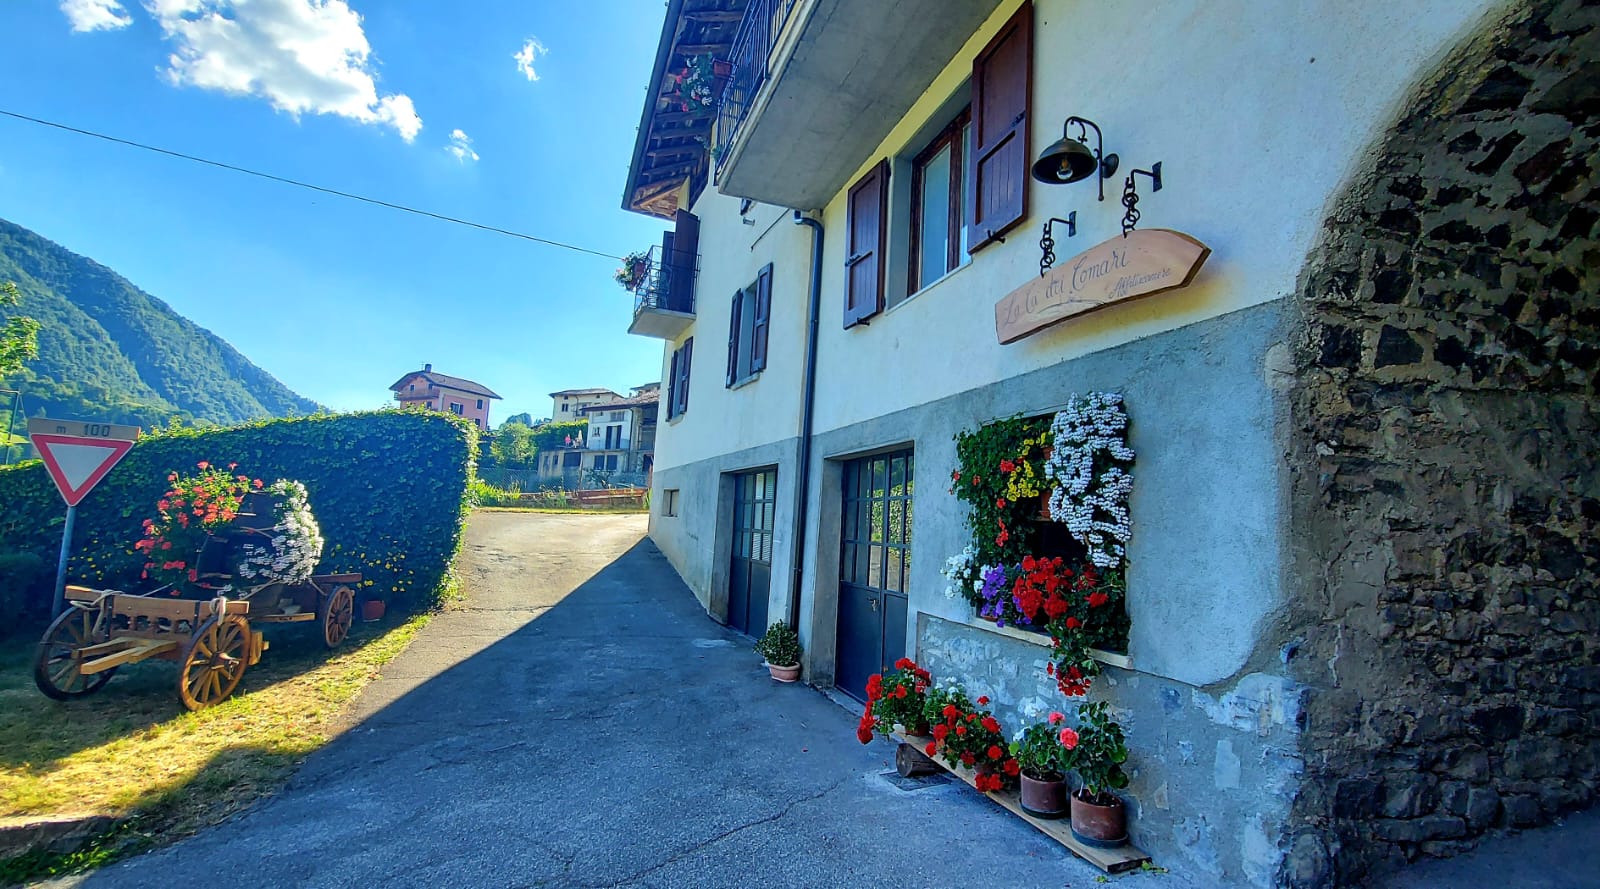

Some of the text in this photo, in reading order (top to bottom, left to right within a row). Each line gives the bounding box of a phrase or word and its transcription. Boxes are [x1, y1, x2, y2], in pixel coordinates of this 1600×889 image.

[1004, 294, 1021, 325] La
[1072, 248, 1130, 291] Comari
[56, 423, 111, 437] m 100
